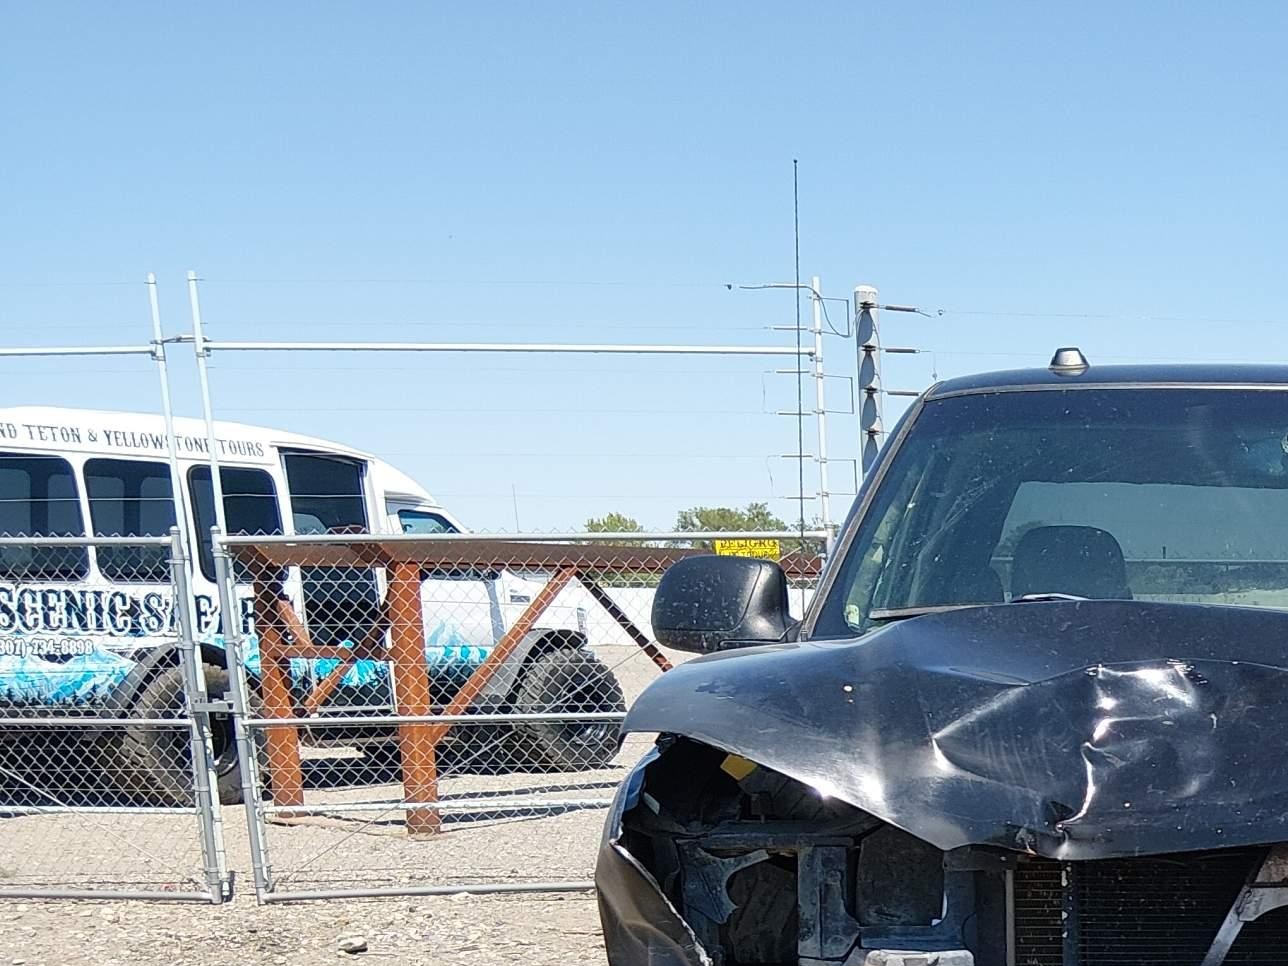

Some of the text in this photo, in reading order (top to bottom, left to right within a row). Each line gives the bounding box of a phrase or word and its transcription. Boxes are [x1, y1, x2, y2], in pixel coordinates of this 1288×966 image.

[22, 423, 82, 444] TETON
[88, 429, 99, 443] &
[214, 439, 265, 457] TOURS
[0, 586, 131, 635] SCENIC
